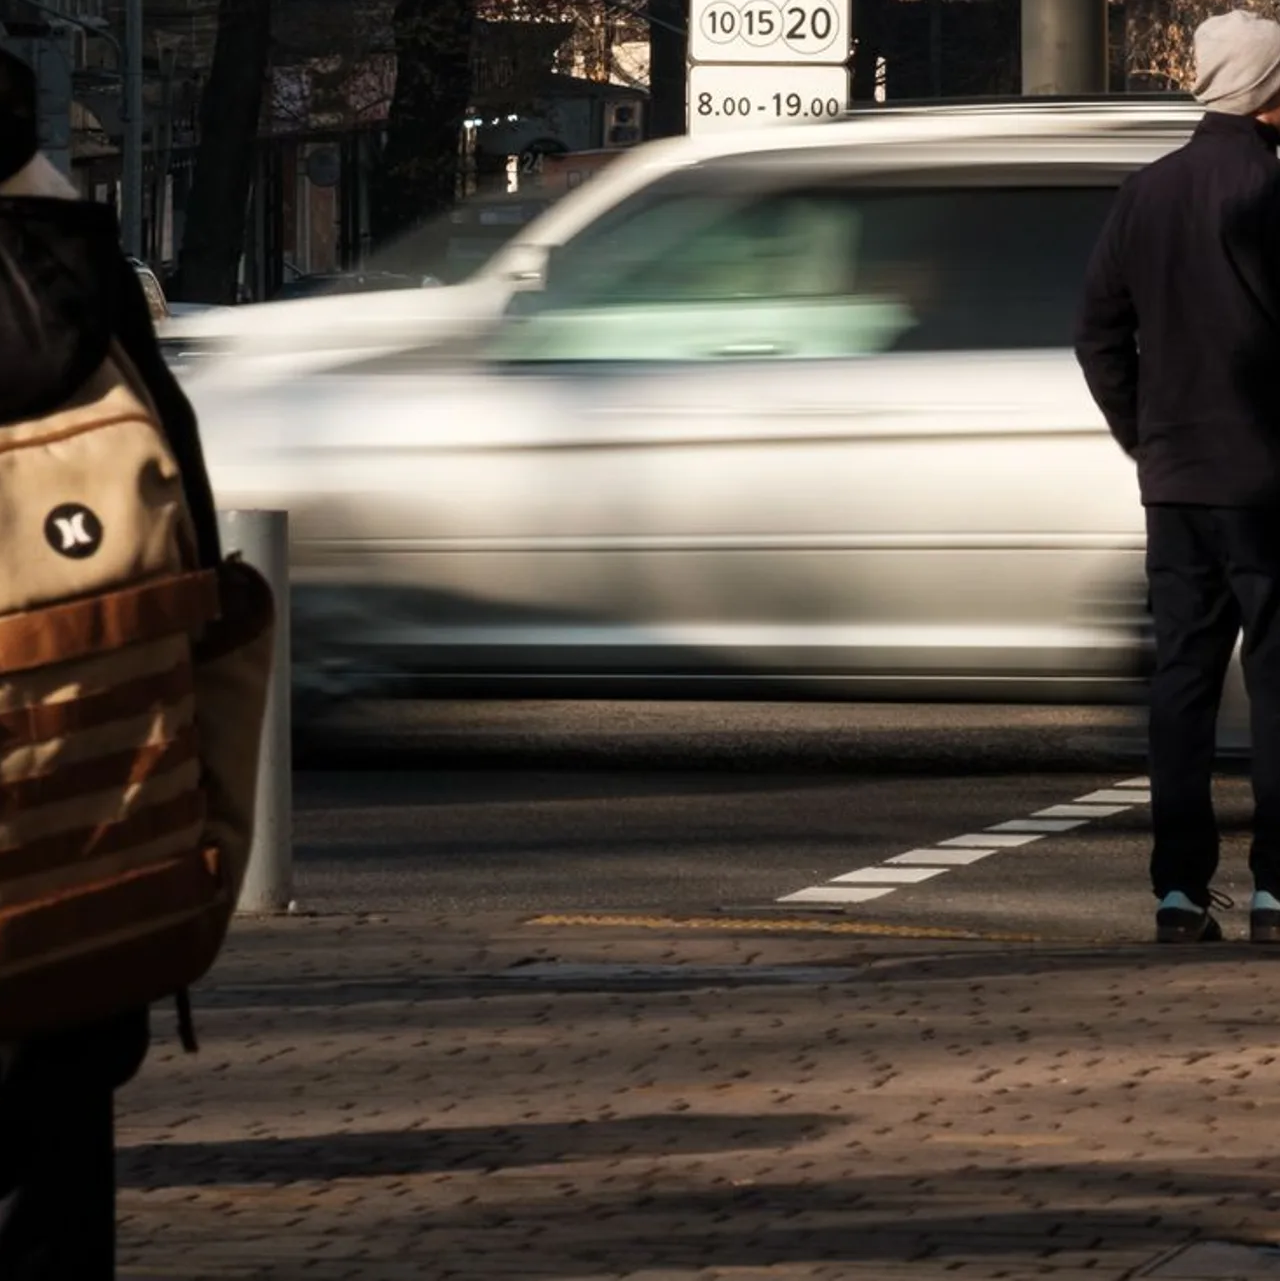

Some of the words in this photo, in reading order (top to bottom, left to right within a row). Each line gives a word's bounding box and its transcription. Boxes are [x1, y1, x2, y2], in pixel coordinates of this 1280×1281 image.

[708, 10, 735, 34] 10
[744, 10, 774, 35] 15
[786, 7, 832, 40] 20
[697, 92, 751, 117] 8.00
[773, 93, 839, 117] 19.00
